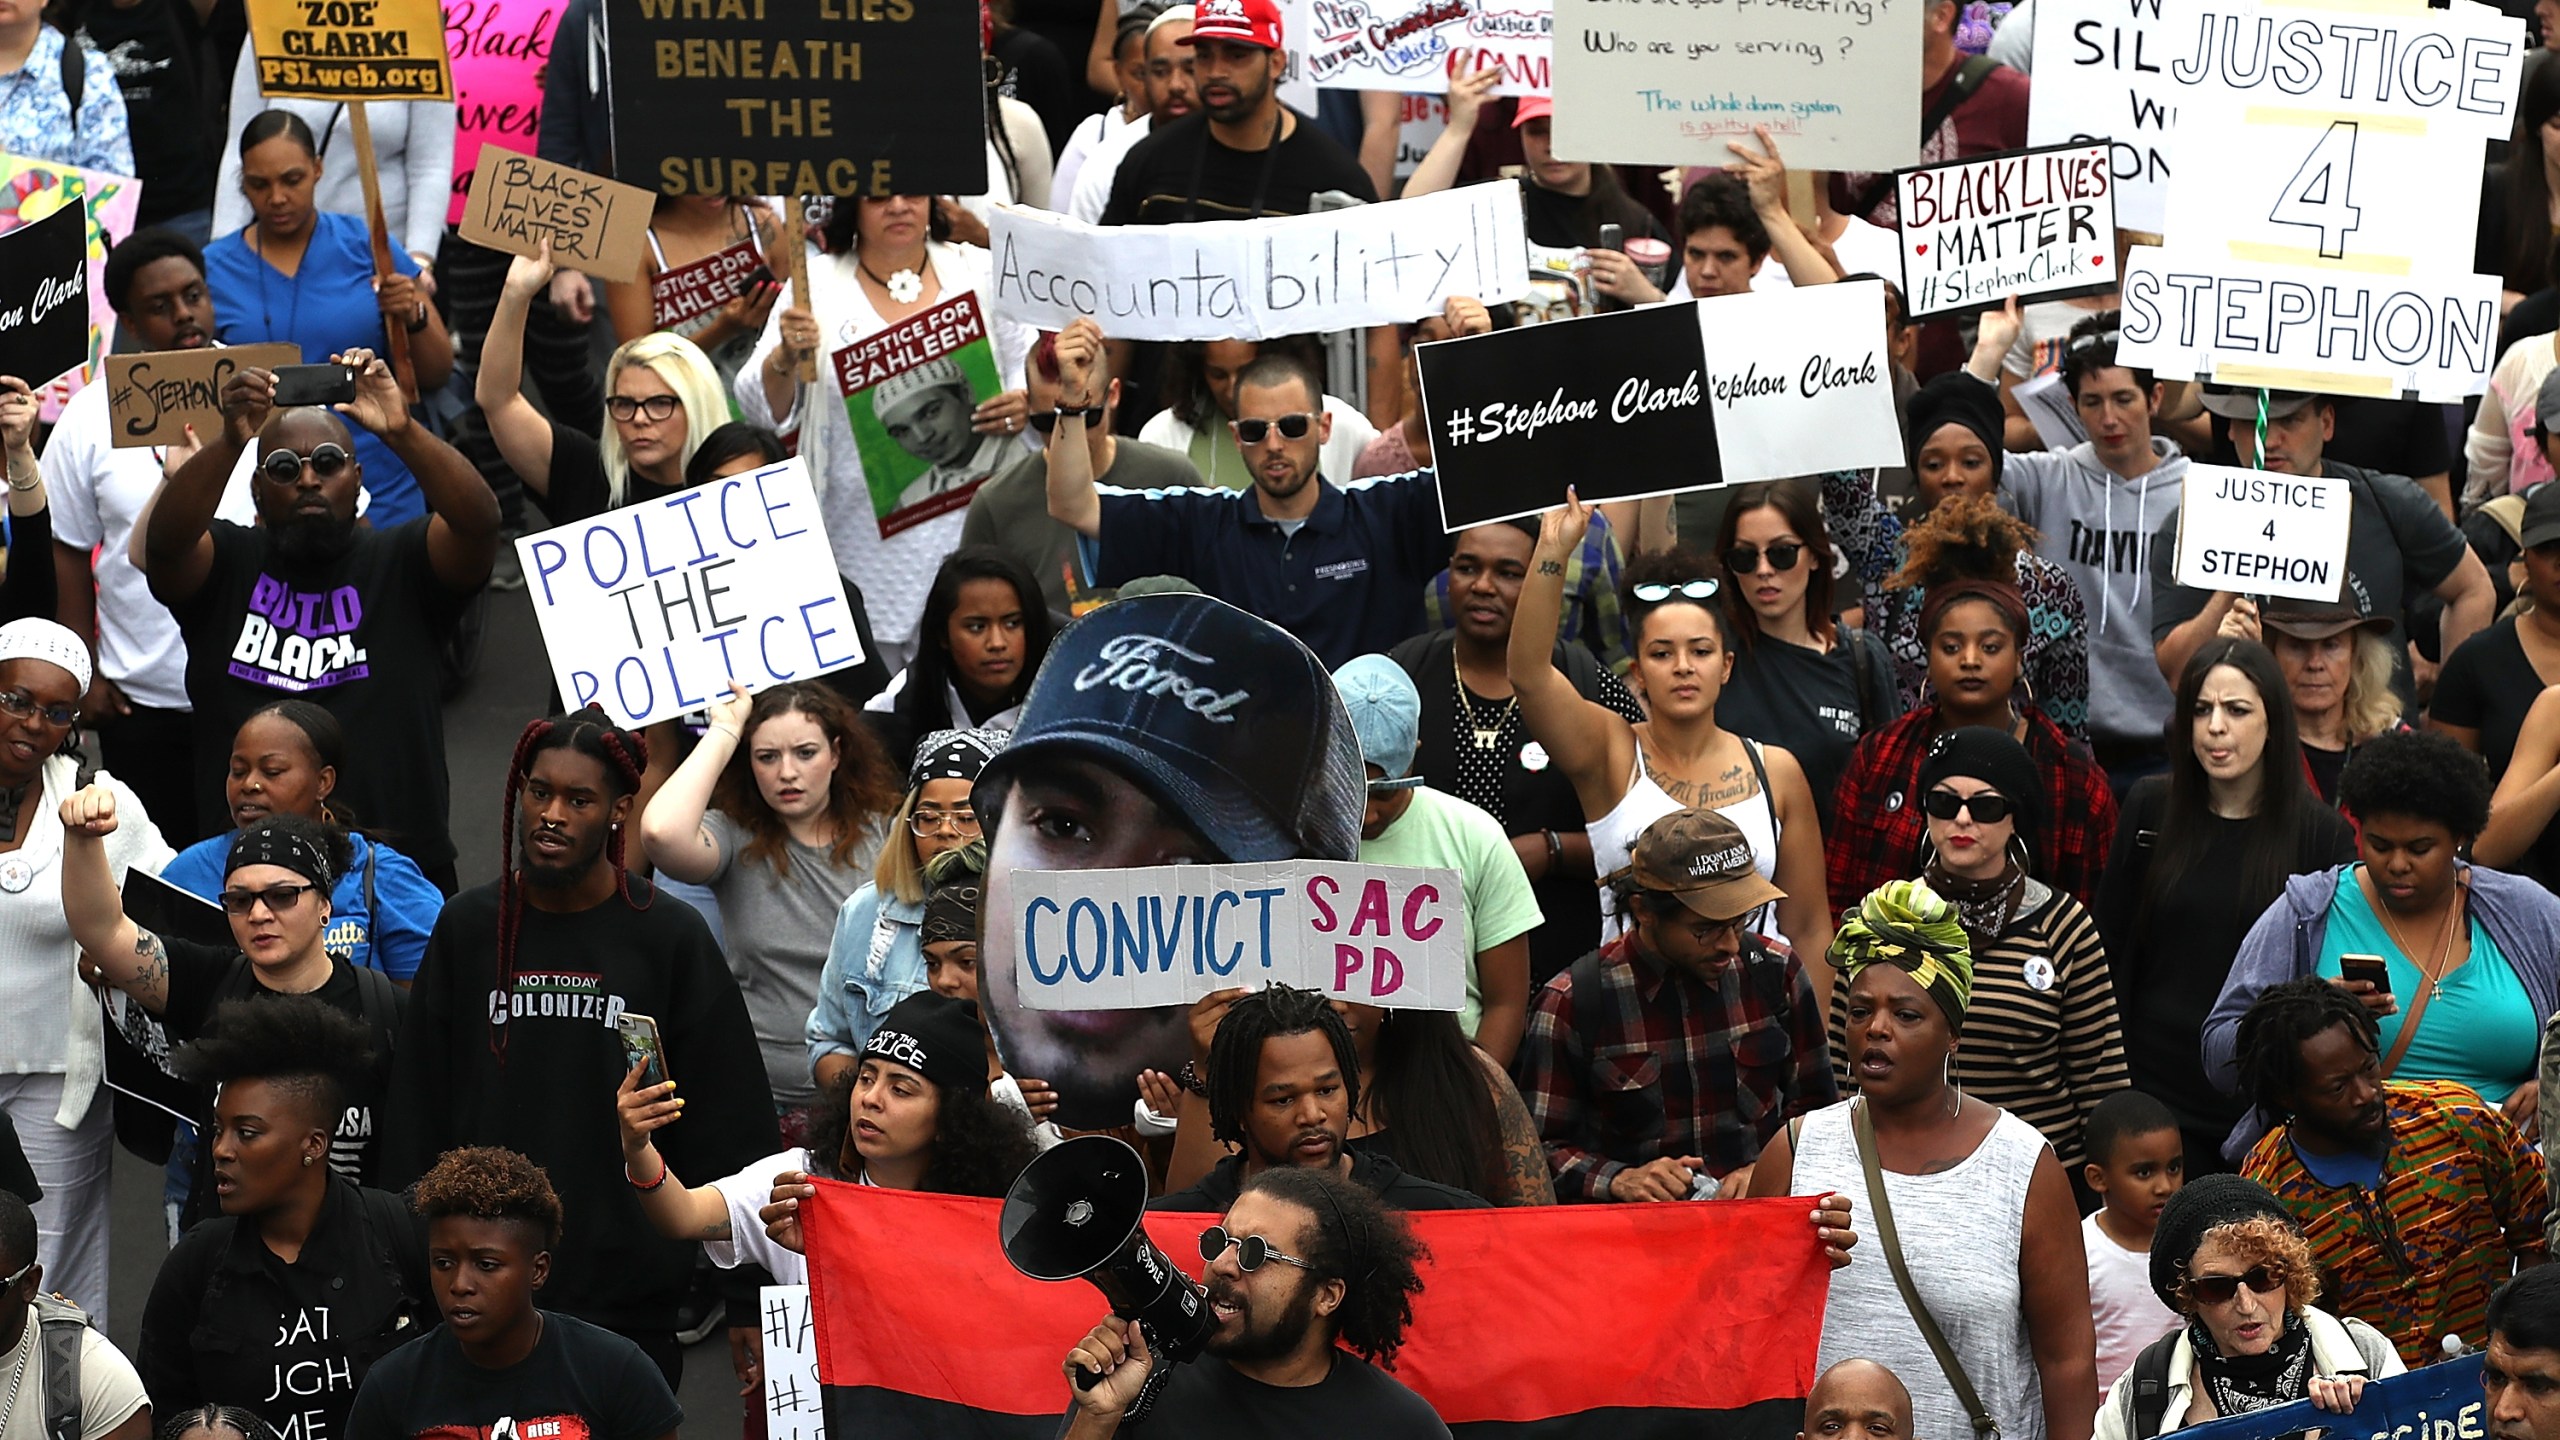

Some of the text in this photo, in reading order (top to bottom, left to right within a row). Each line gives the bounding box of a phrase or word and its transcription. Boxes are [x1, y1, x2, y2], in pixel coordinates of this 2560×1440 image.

[282, 30, 408, 57] CLARK!
[655, 39, 862, 81] BENEATH
[1584, 29, 1638, 53] Who
[1647, 41, 1675, 54] are
[1687, 43, 1721, 60] you
[1735, 40, 1824, 65] serving
[2074, 20, 2160, 74] SIL
[2172, 13, 2512, 116] JUSTICE
[261, 60, 438, 91] PSLweb.org
[455, 92, 540, 137] ives
[726, 98, 833, 138] THE
[1636, 89, 1682, 112] The
[504, 158, 603, 208] BLACK
[659, 155, 892, 198] SURFACE
[2269, 121, 2361, 259] 4
[503, 187, 591, 228] LIVES
[492, 212, 588, 260] MATTER
[999, 194, 1502, 319] Accountability!!
[1936, 205, 2097, 271] MATTER
[709, 250, 752, 278] FOR
[31, 260, 83, 324] Clark
[843, 300, 971, 369] JUSTICE FOR
[2123, 270, 2493, 373] STEPHON
[845, 316, 981, 391] SAHLEEM
[1799, 350, 1878, 399] Clark
[1447, 369, 1701, 447] #Stephon Clark
[2216, 478, 2327, 509] JUSTICE
[531, 466, 808, 606] POLICE
[2262, 519, 2276, 541] 4
[2202, 549, 2329, 584] STEPHON
[248, 571, 363, 638] BUILD
[608, 558, 748, 650] THE
[571, 596, 856, 721] POLICE
[1073, 634, 1250, 722] Ford
[1688, 861, 1720, 876] WHAT
[1025, 875, 1444, 986] CONVICT SAC
[519, 975, 598, 989] NOT TODAY
[1332, 943, 1405, 998] PD
[489, 990, 626, 1031] COLONIZER
[899, 1033, 919, 1048] THE
[527, 1421, 561, 1439] RISE
